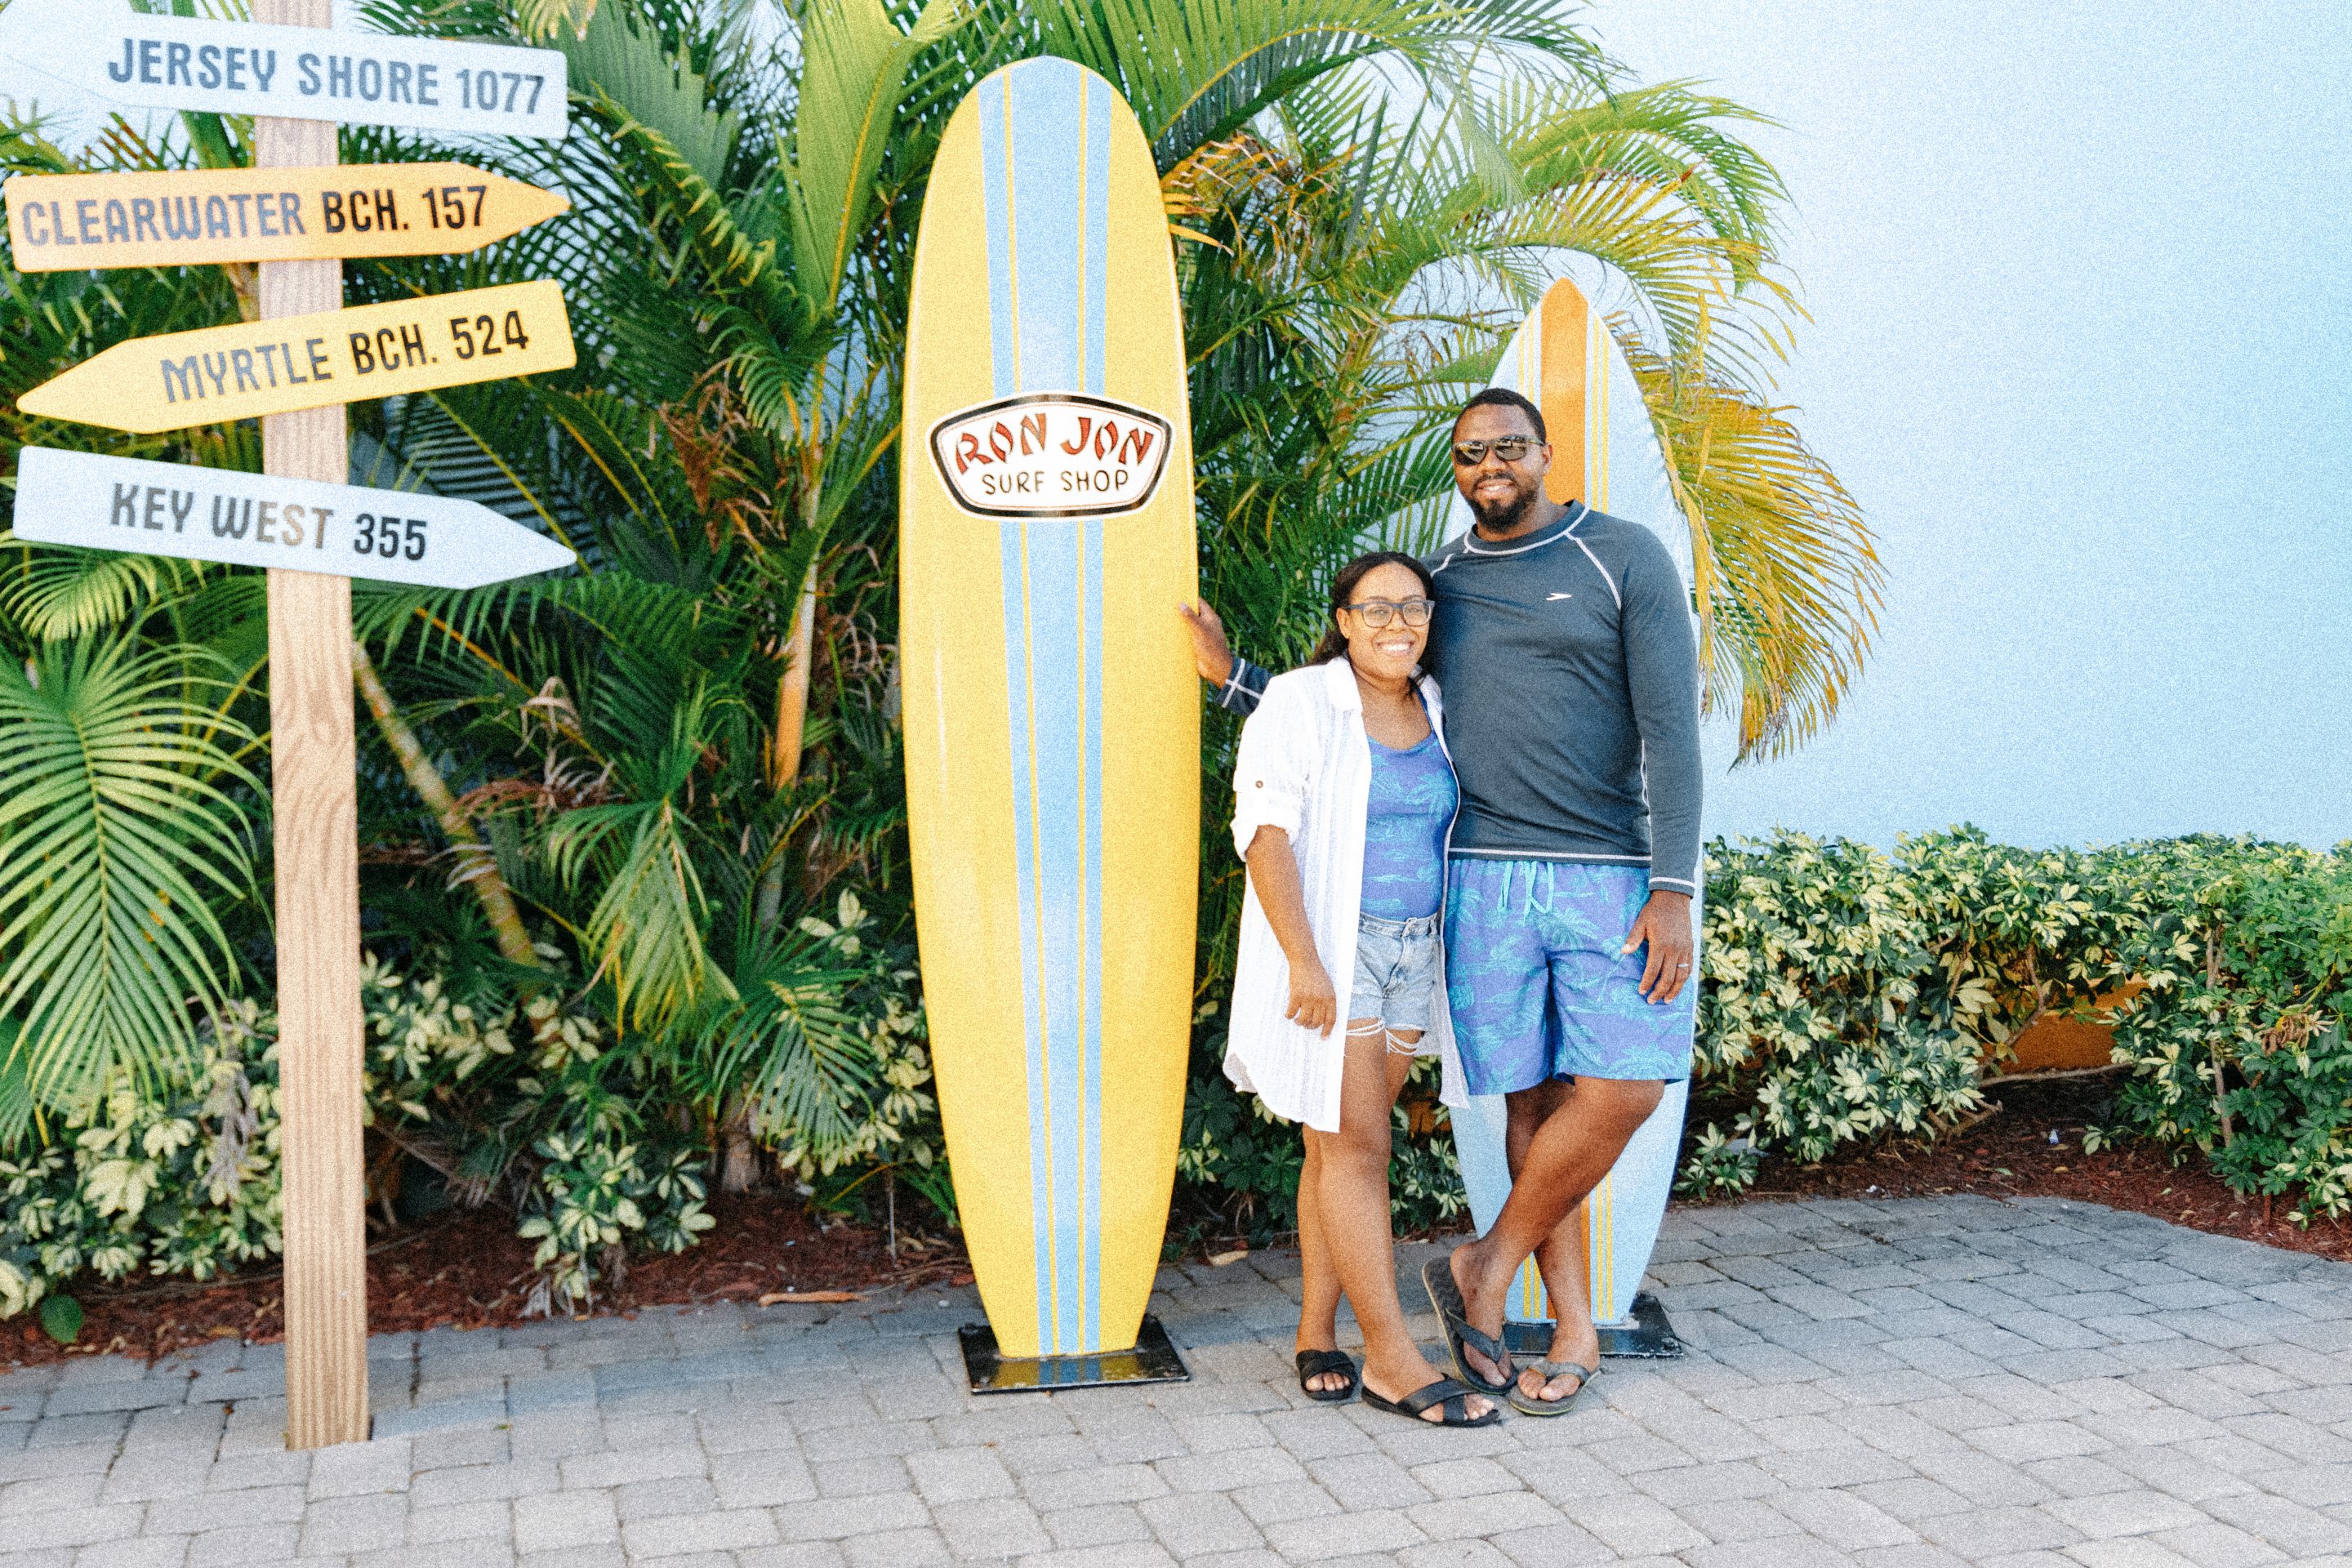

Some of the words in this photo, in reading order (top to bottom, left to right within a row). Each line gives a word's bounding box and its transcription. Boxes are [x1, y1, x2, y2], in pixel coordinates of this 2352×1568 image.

[109, 38, 277, 92] JERSEY
[298, 52, 439, 106] SHORE
[456, 69, 545, 114] 1077
[22, 191, 306, 246] CLEARWATER
[322, 189, 409, 234] BCH.
[421, 185, 488, 229] 157
[160, 338, 332, 403] MYRTLE
[350, 324, 439, 375] BCH.
[450, 310, 529, 359] 524
[955, 413, 1047, 475] RON
[1060, 416, 1154, 466] JON
[982, 471, 1045, 495] SURF
[1061, 470, 1129, 492] SHOP
[111, 483, 194, 532] KEY
[212, 496, 334, 550] WEST
[354, 514, 428, 560] 355
